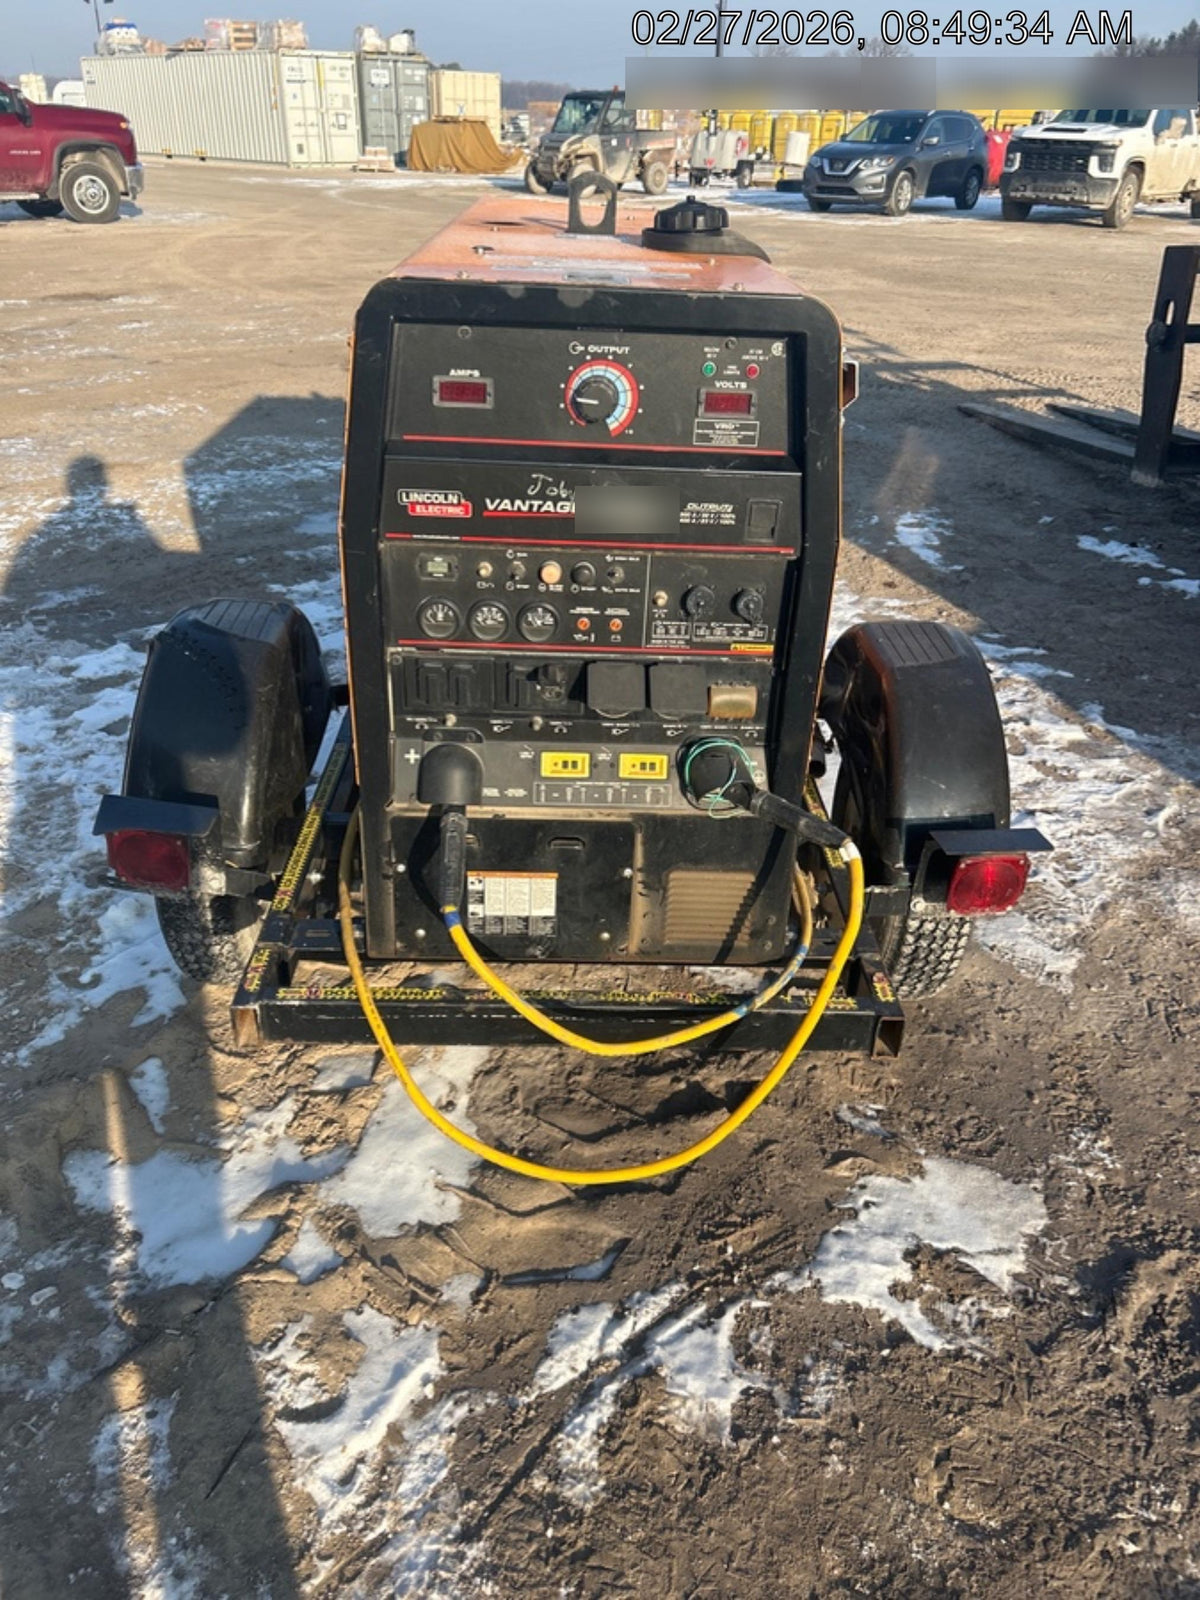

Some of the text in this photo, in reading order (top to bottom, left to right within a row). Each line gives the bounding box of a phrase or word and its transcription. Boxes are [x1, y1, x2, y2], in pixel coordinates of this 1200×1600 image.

[587, 345, 630, 355] OUTPUT
[449, 368, 480, 377] AMPS
[714, 380, 747, 389] VOLTS
[402, 492, 459, 504] LINCOLN
[415, 503, 465, 515] ELECTRIC
